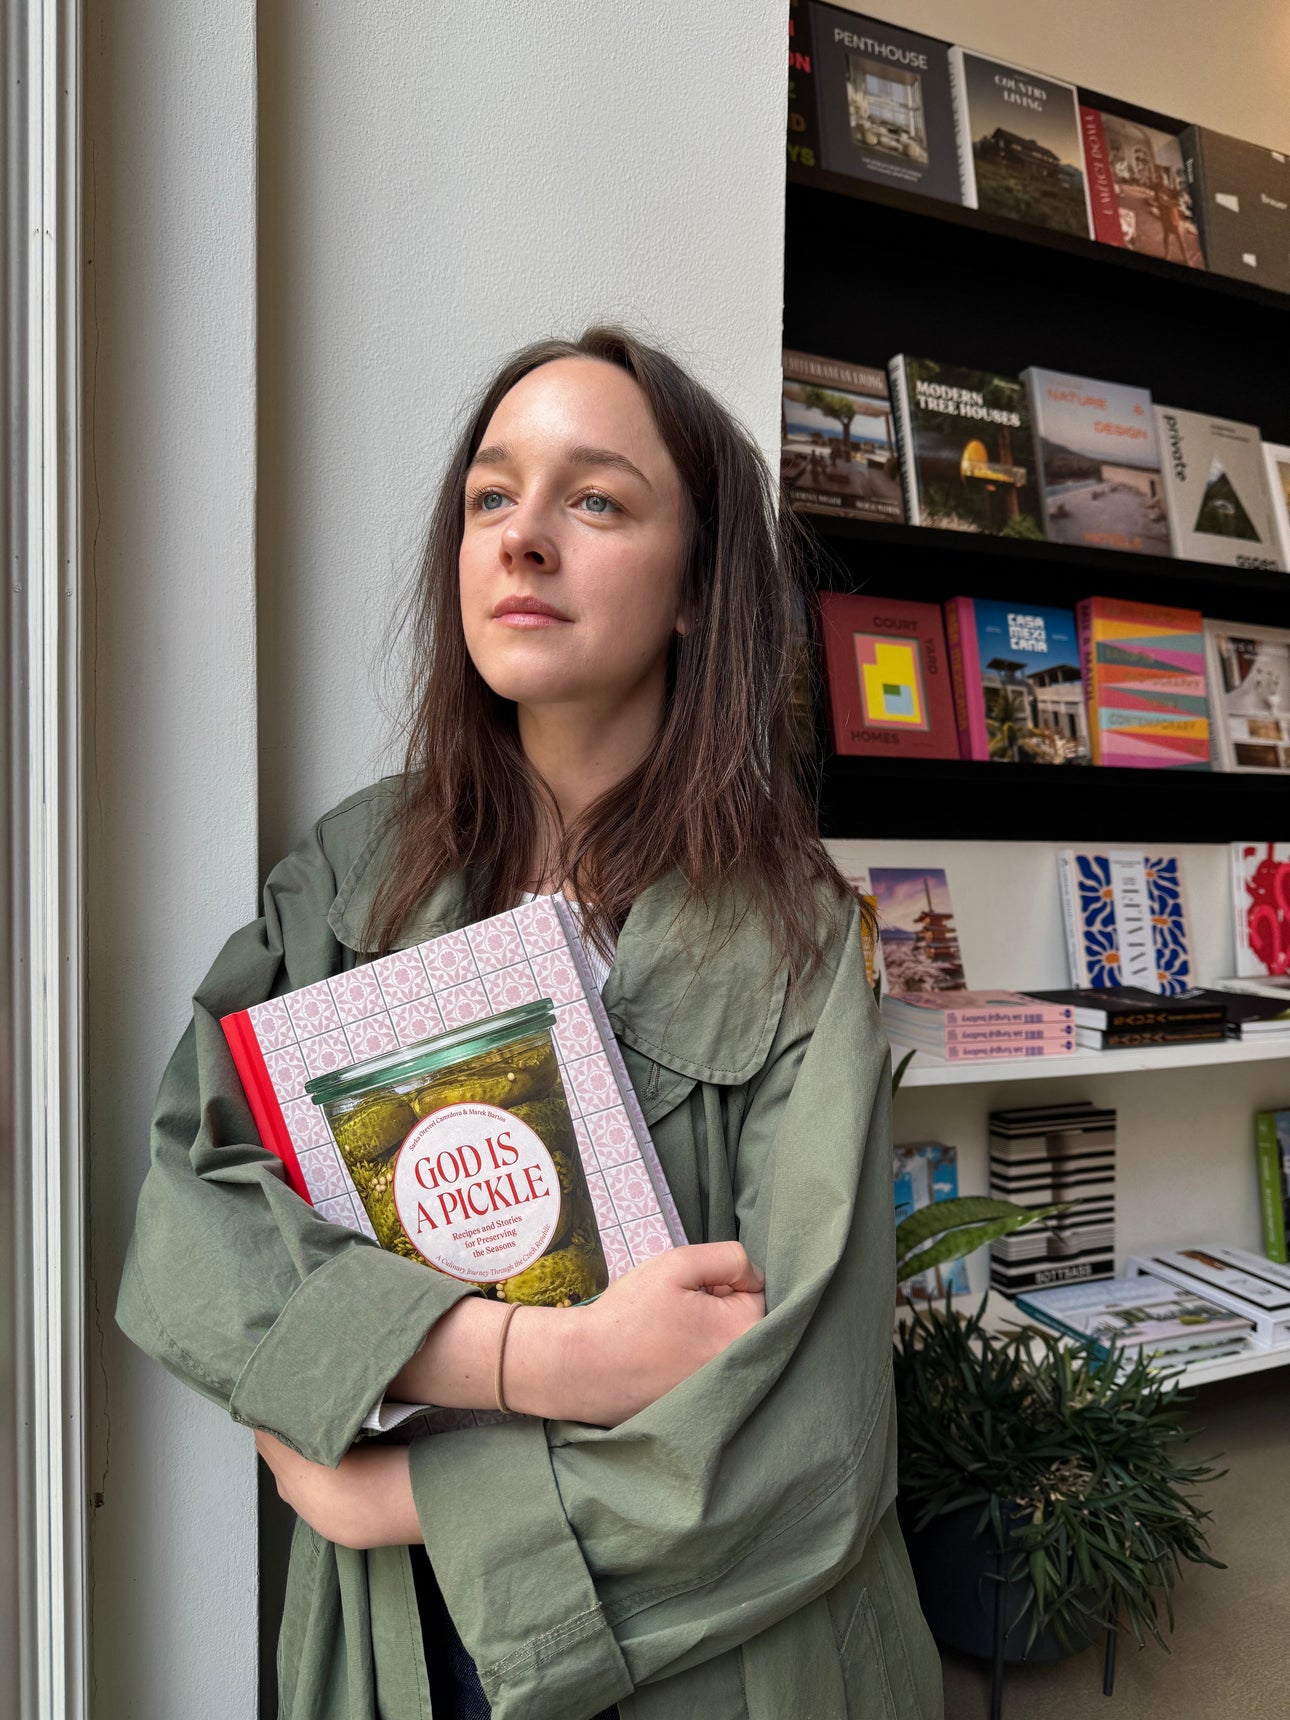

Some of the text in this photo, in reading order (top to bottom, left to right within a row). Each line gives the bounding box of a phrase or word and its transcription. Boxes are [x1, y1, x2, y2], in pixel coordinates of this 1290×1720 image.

[834, 28, 929, 70] PENTHOUSE
[915, 380, 984, 406] MODERN
[1047, 388, 1107, 411] NATURE
[917, 395, 1021, 428] TREE HOUSES
[1094, 421, 1147, 440] DESIGN
[1163, 414, 1188, 483] private
[873, 616, 919, 631] COURT
[1007, 612, 1045, 628] CASA
[1009, 625, 1047, 641] MEXI
[924, 638, 938, 676] YARD
[1010, 637, 1048, 654] CANA
[850, 729, 900, 745] HOMES
[415, 1131, 520, 1190] GOD IS
[416, 1164, 550, 1234] A PICKLE
[452, 1215, 523, 1241] Recipes and Stories
[464, 1228, 518, 1249] for Preserving
[435, 1223, 551, 1278] A Culinary Journey Through the Czech Republic
[472, 1240, 517, 1259] the Seasons
